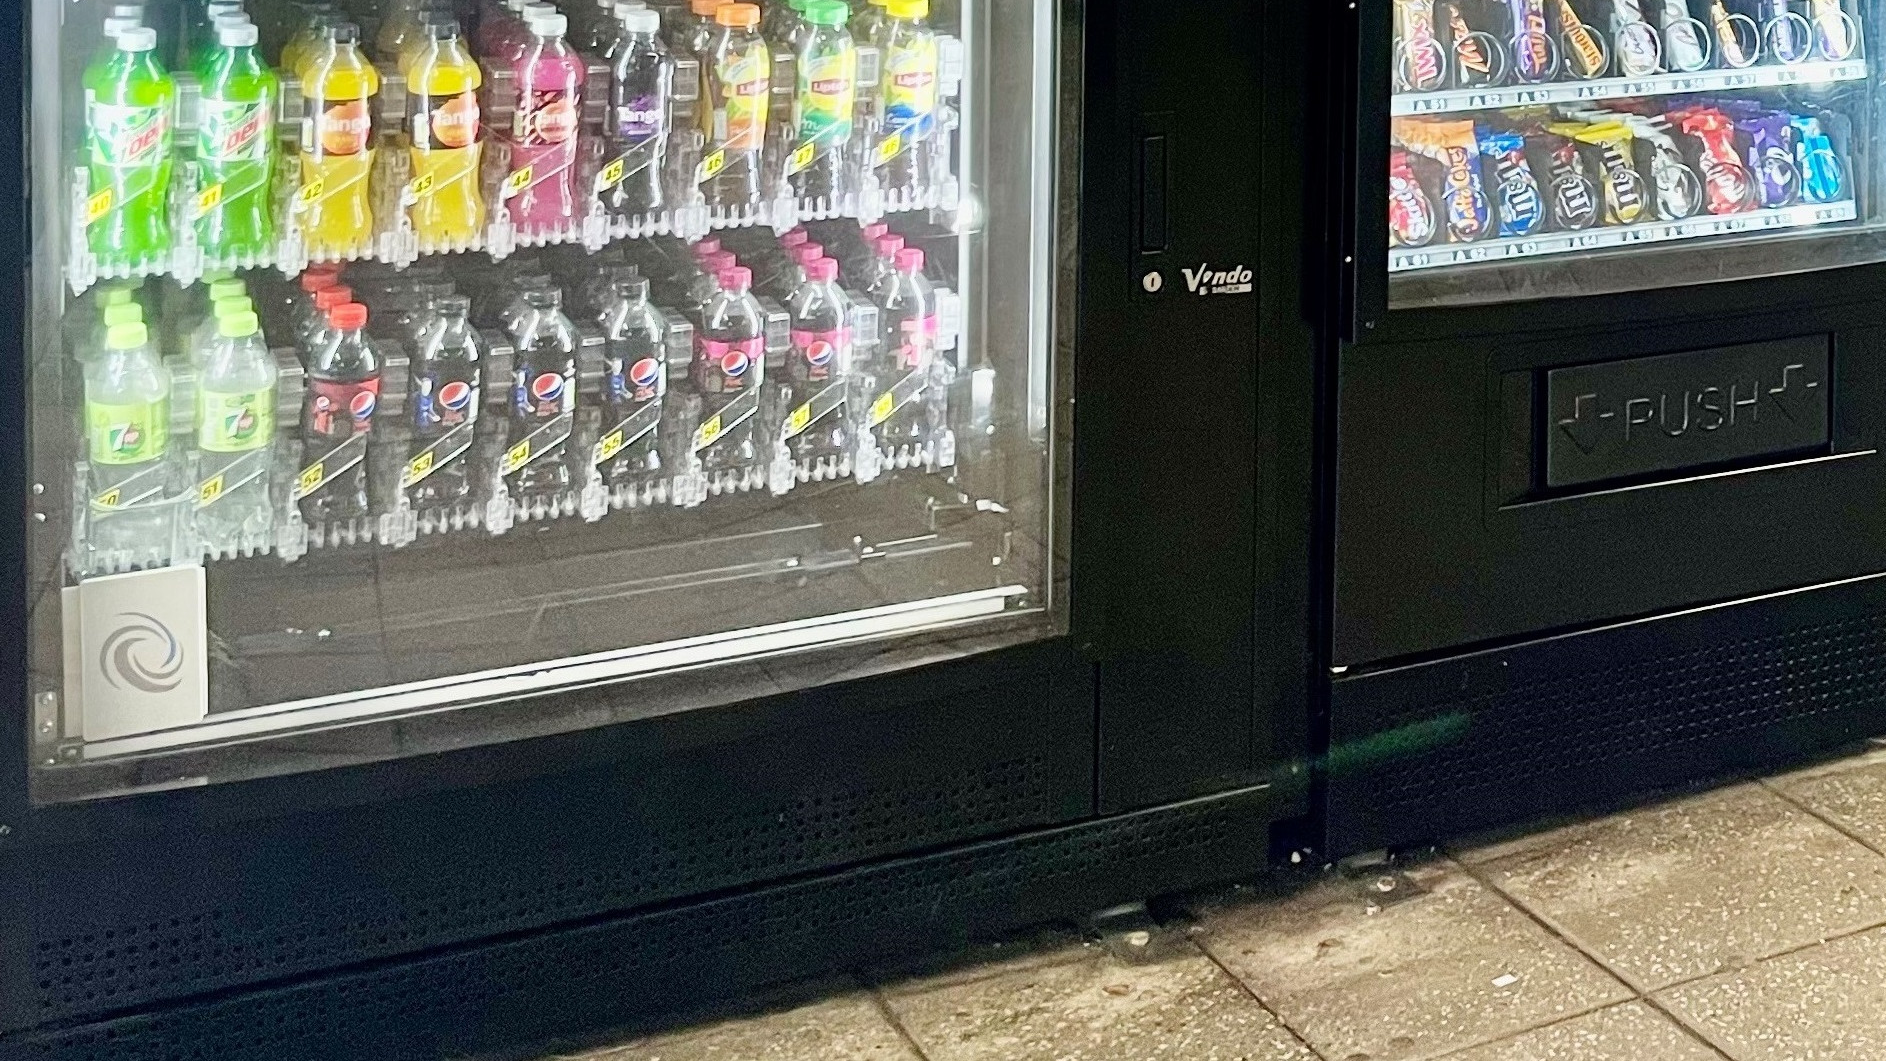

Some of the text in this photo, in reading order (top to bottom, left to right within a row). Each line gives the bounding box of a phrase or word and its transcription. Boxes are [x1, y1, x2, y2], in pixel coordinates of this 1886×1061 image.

[706, 156, 722, 172] 46
[797, 148, 813, 163] 47
[513, 169, 531, 185] 44
[605, 164, 621, 180] 45
[303, 182, 322, 199] 42
[416, 176, 432, 193] 43
[90, 194, 110, 213] 40
[200, 190, 219, 207] 41
[1181, 262, 1253, 293] Vendo
[794, 408, 810, 426] 57
[1625, 380, 1759, 441] PUSH
[704, 421, 720, 437] 56
[603, 437, 620, 454] 55
[512, 447, 528, 464] 54
[414, 457, 431, 474] 53
[303, 470, 321, 488] 52
[203, 480, 219, 496] 51
